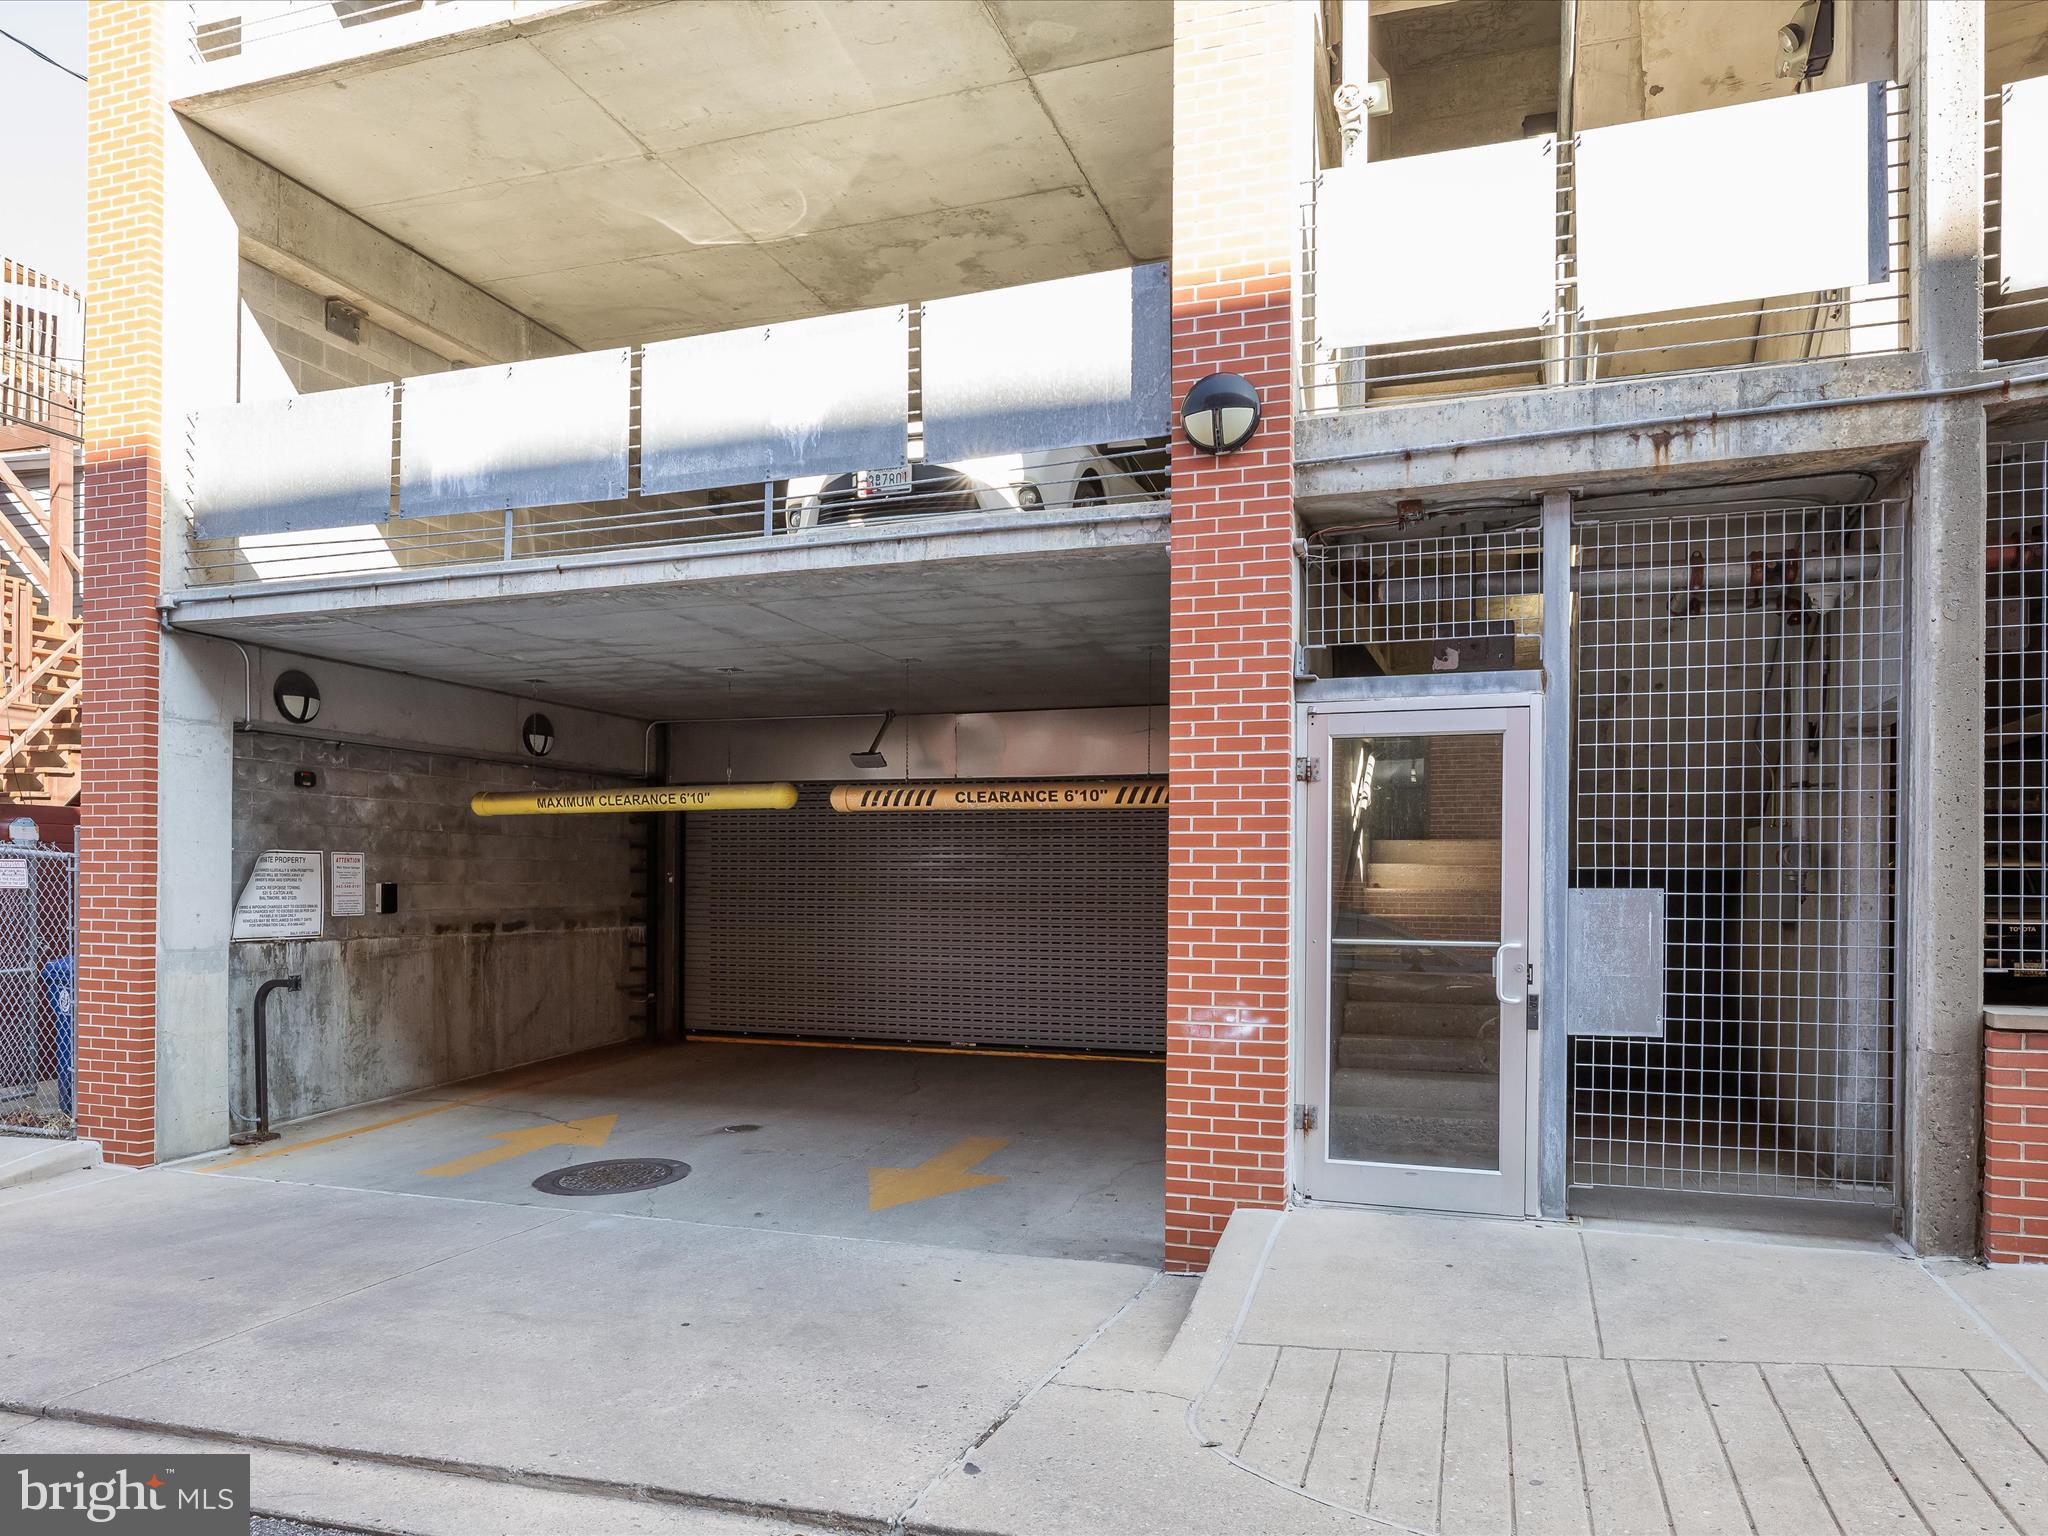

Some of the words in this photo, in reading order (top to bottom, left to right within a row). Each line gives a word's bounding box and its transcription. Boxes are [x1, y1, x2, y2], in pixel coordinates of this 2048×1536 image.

[537, 796, 595, 808] MAXIMUM
[600, 793, 677, 806] CLEARANCE
[680, 792, 710, 804] 6'10"
[955, 790, 1058, 803] CLEARANCE
[1064, 789, 1108, 802] 6'10"
